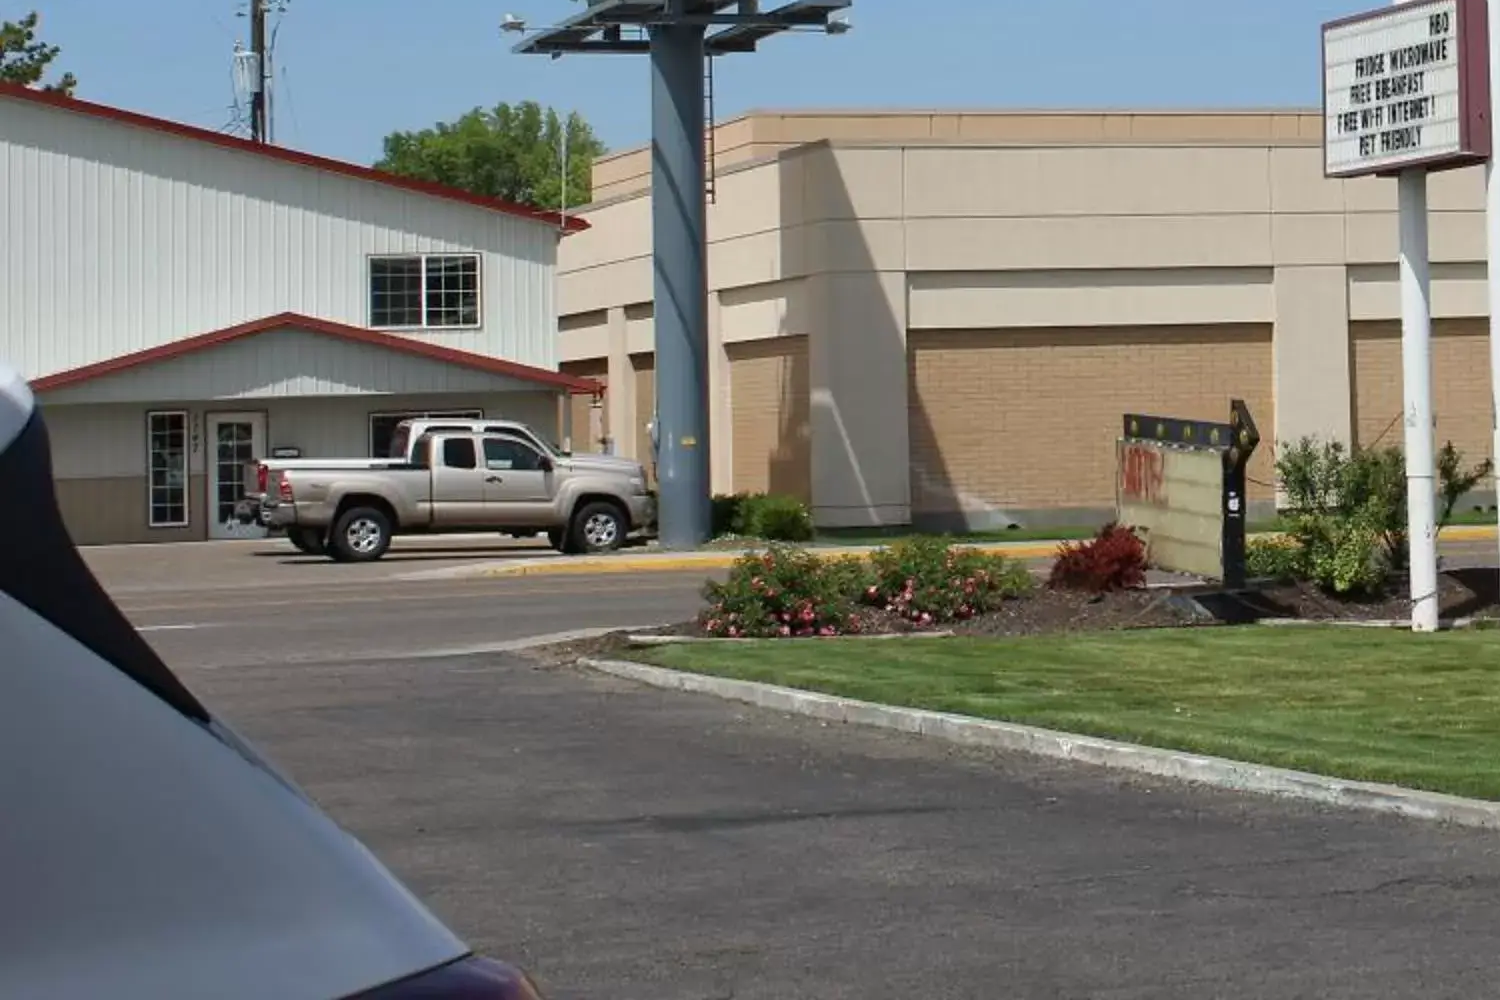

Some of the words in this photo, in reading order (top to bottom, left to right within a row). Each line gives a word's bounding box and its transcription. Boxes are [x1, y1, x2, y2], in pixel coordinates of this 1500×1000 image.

[1429, 12, 1449, 36] HBO
[1355, 53, 1384, 78] FRIDGE
[1390, 38, 1448, 71] MICROWAVE
[1350, 81, 1371, 104] FREE
[1375, 71, 1425, 101] BREAKFAST
[1338, 110, 1358, 134] FREE
[1359, 134, 1376, 156] PET
[1381, 125, 1423, 152] FRIENDLY
